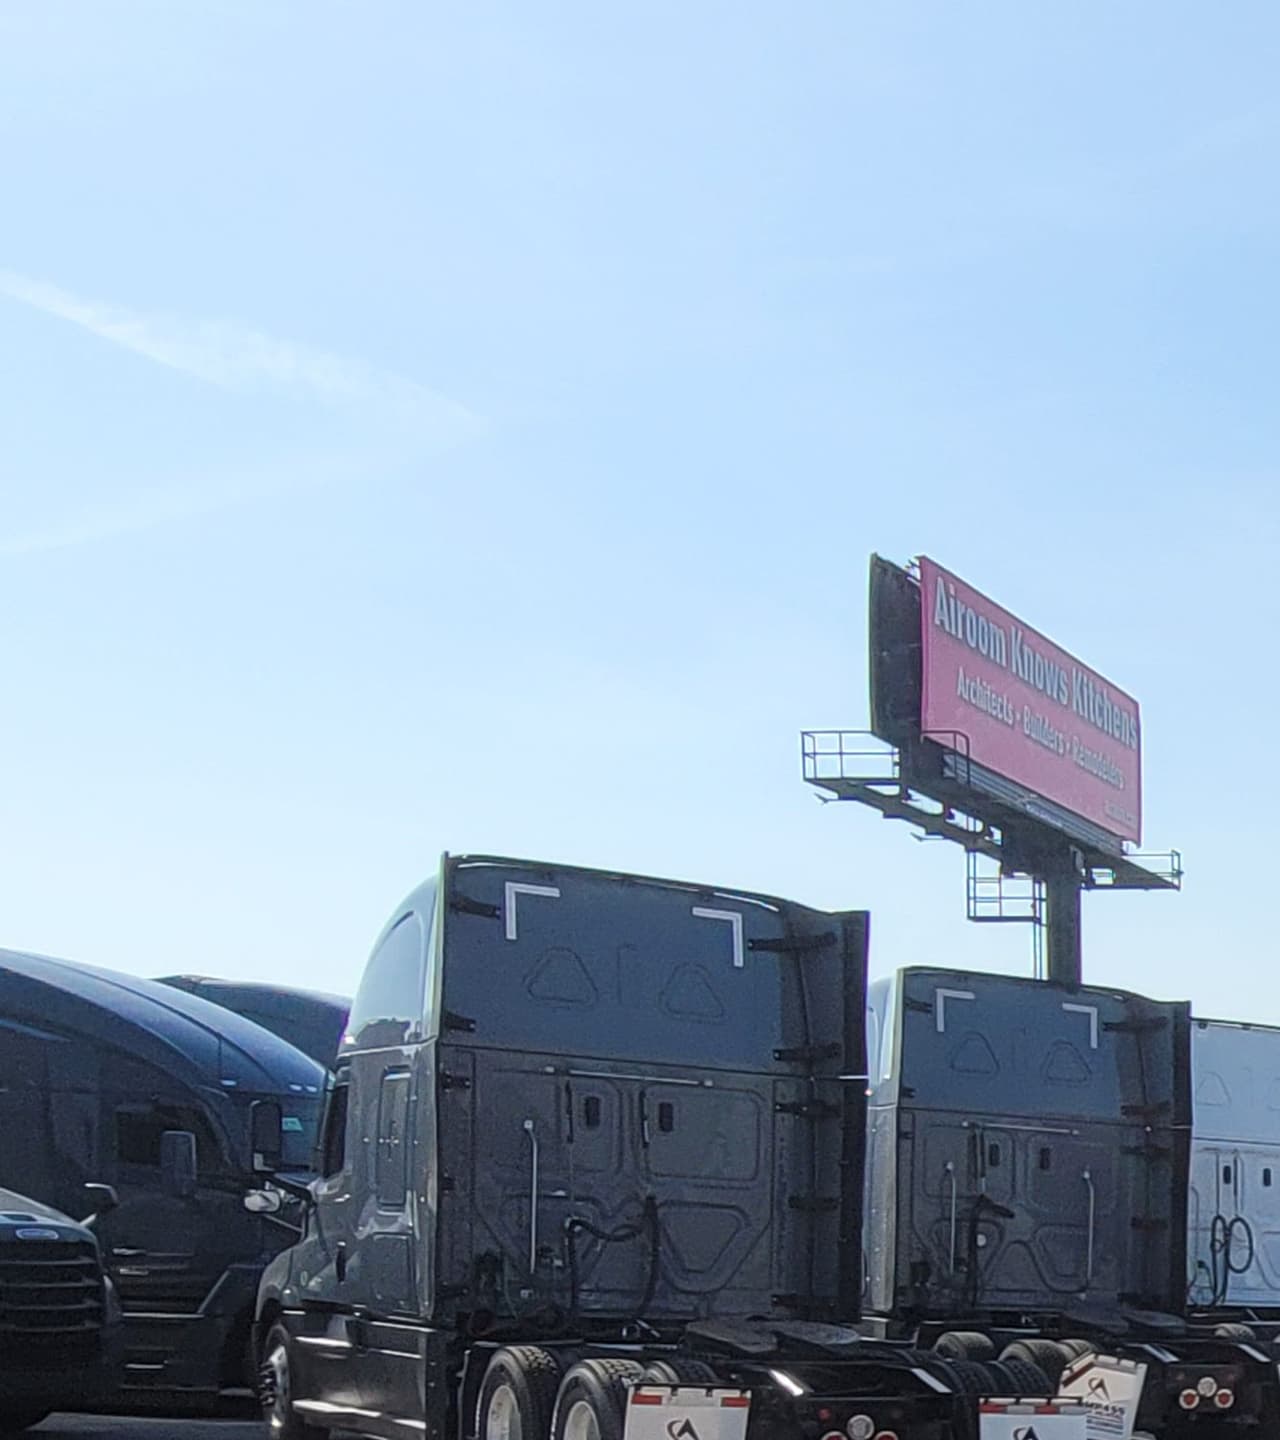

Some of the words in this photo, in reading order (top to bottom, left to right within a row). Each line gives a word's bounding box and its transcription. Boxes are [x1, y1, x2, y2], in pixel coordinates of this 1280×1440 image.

[934, 577, 1006, 666] Airoom
[1011, 627, 1068, 703] Knows
[1073, 669, 1137, 748] Kitchens
[958, 668, 1014, 725] Architects
[1022, 704, 1066, 755] Builders
